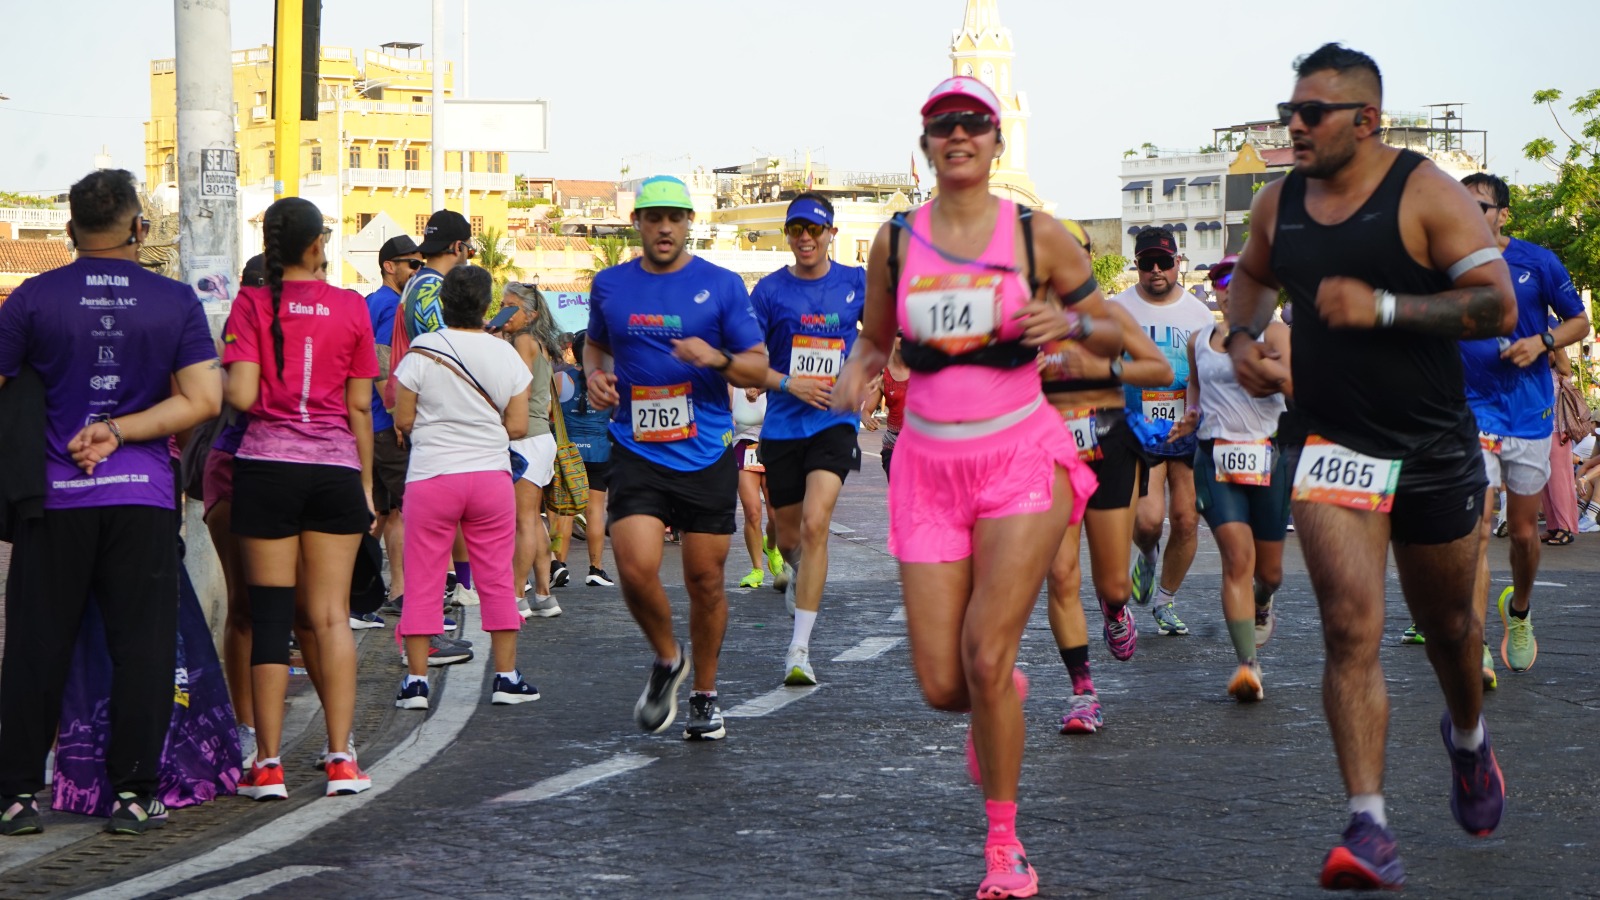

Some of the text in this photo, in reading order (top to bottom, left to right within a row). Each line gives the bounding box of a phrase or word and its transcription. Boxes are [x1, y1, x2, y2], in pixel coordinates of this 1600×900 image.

[206, 150, 221, 170] SE
[289, 302, 330, 316] Edna Ro
[797, 354, 833, 374] 3070
[638, 407, 680, 428] 2762
[1152, 406, 1176, 421] 894
[1221, 452, 1257, 471] 1693
[130, 474, 149, 483] CLUB
[1309, 455, 1375, 488] 4865
